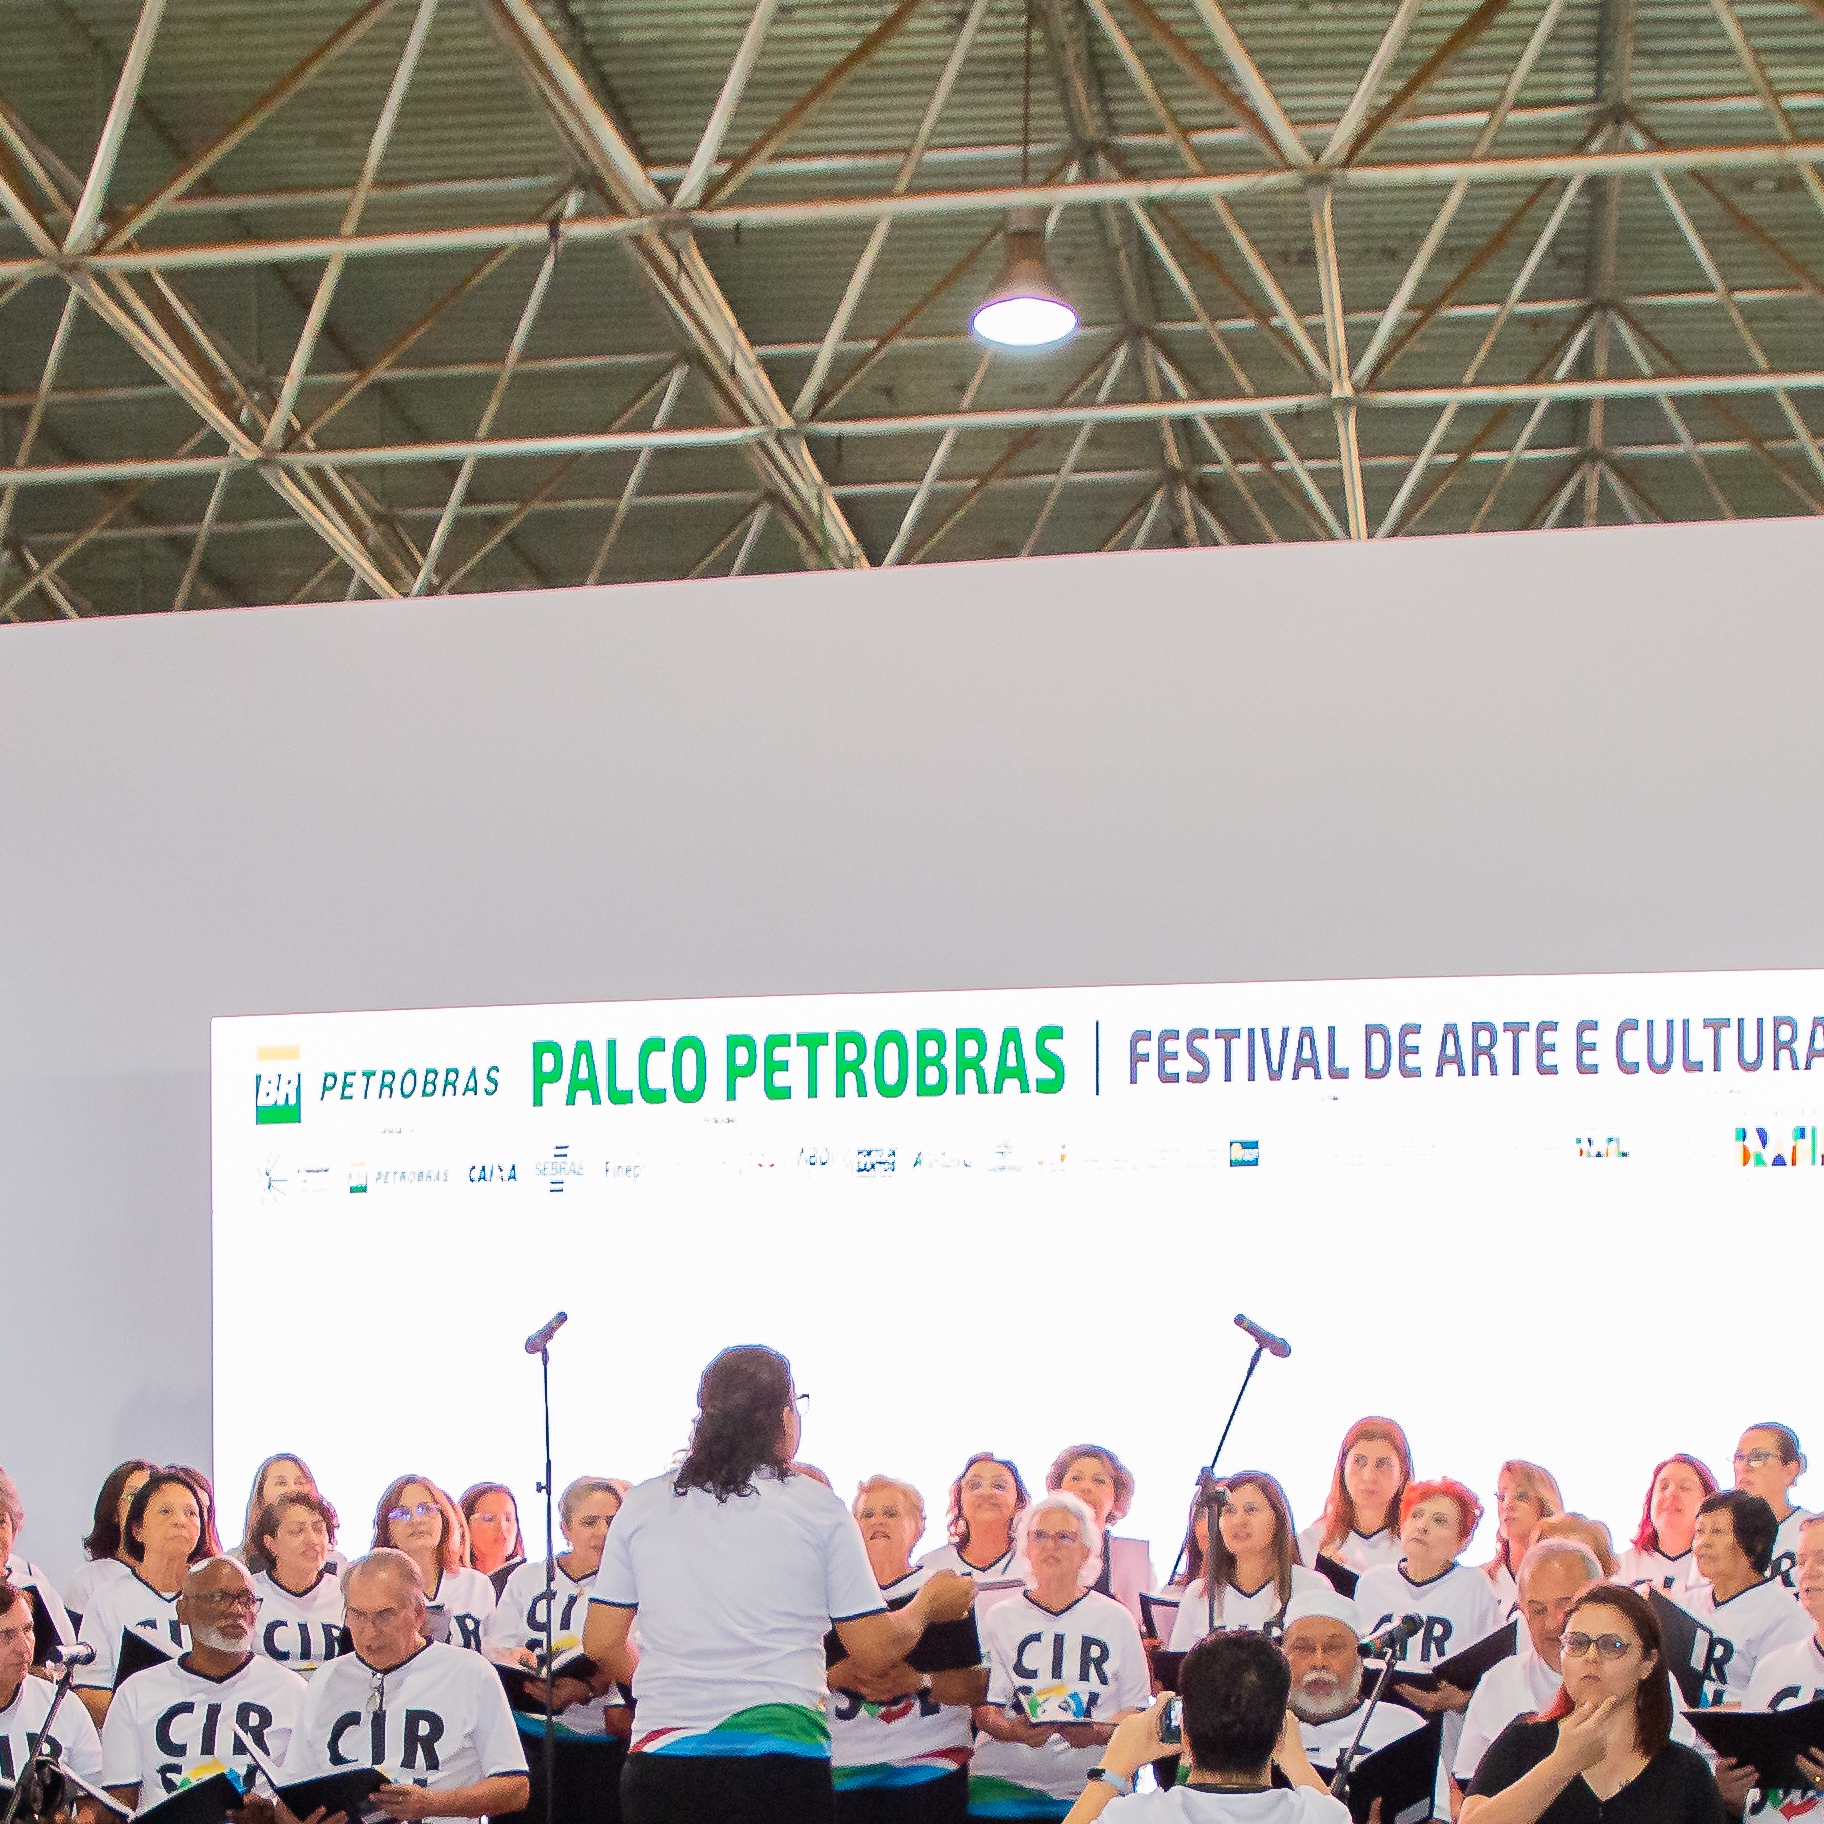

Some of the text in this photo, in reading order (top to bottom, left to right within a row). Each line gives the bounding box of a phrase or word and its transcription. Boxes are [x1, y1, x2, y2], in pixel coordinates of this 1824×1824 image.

[532, 1025, 1066, 1107] PALCO PETROBRAS
[1129, 1024, 1350, 1084] FESTIVAL
[1365, 1022, 1422, 1078] DE
[1436, 1020, 1559, 1078] ARTE
[1576, 1020, 1600, 1076] E
[320, 1066, 499, 1101] PETROBRAS
[1013, 1630, 1110, 1686] CIR
[156, 1701, 273, 1757] CIR
[327, 1708, 445, 1771] CIR
